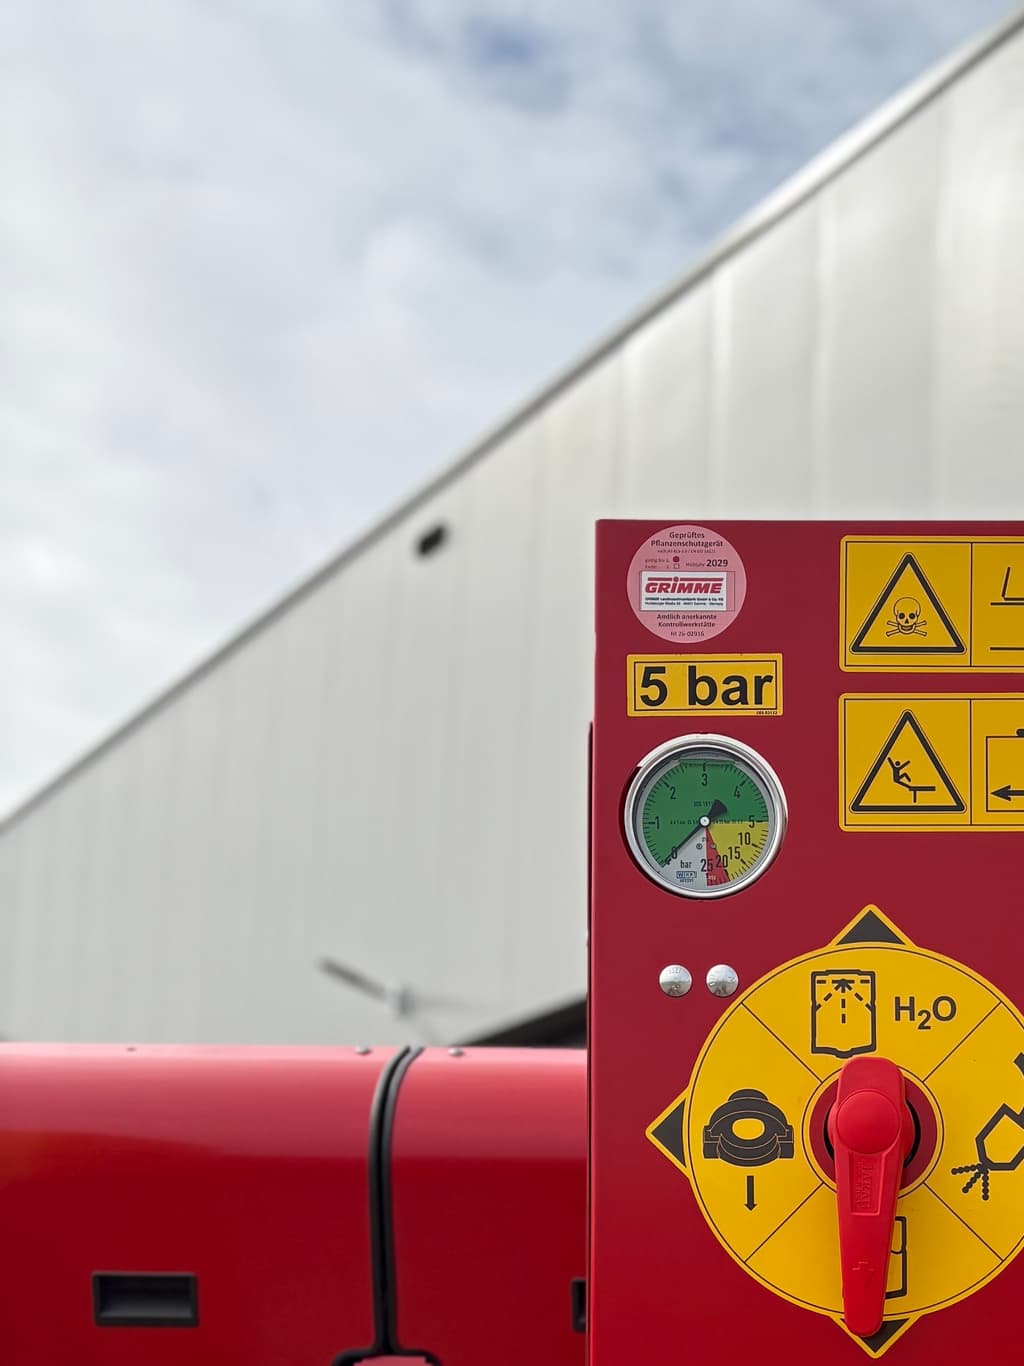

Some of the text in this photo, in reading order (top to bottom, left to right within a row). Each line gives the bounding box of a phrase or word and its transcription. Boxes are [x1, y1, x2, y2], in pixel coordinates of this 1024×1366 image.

[669, 531, 705, 540] Geprüftes
[651, 540, 723, 548] Pflanzenschutzgerät
[706, 559, 728, 568] 2029
[640, 665, 773, 707] 5 bar
[701, 773, 708, 786] 3
[669, 786, 677, 800] 2
[733, 786, 741, 799] 4
[654, 815, 660, 830] 1
[748, 815, 756, 829] 5
[738, 832, 751, 846] 10
[728, 846, 741, 860] 15
[680, 860, 692, 869] bar
[701, 859, 713, 873] 25
[715, 854, 728, 869] 20
